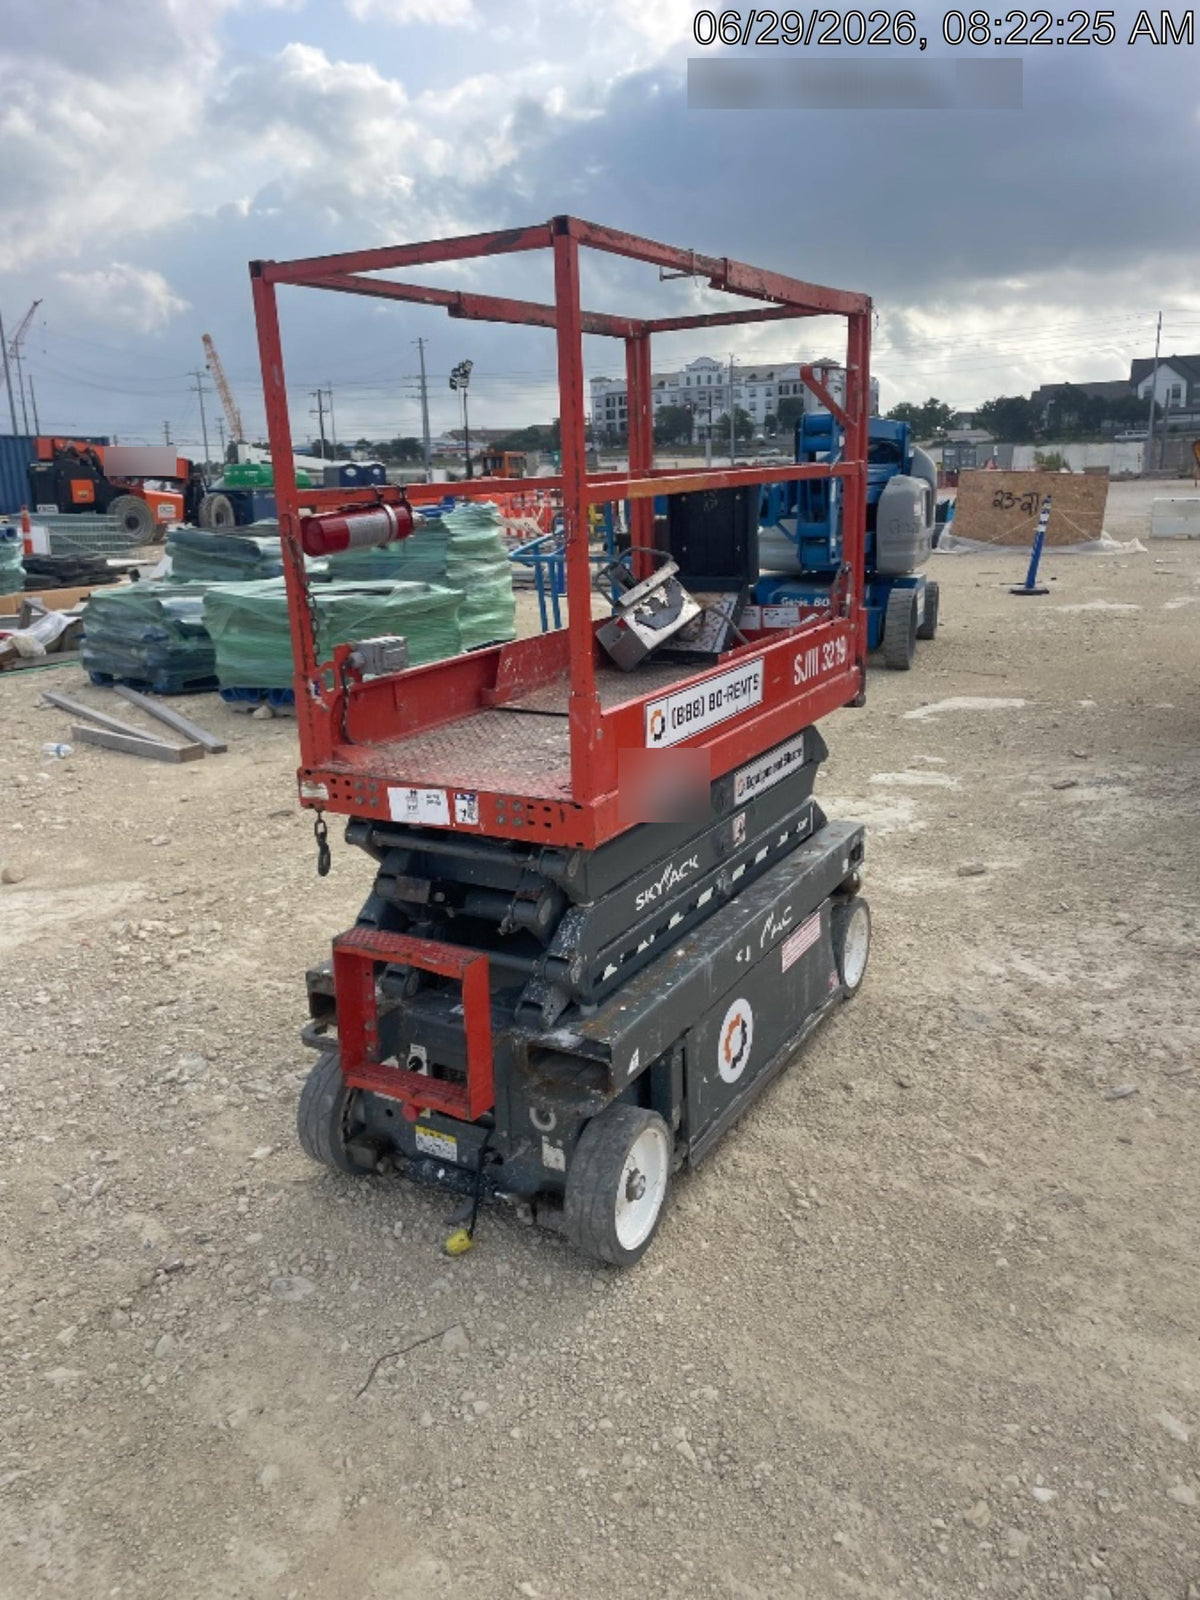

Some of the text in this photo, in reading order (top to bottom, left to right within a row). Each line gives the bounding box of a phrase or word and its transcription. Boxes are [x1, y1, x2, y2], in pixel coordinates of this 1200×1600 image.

[822, 635, 848, 672] 3219
[672, 673, 760, 730] (888) 80-RENTS
